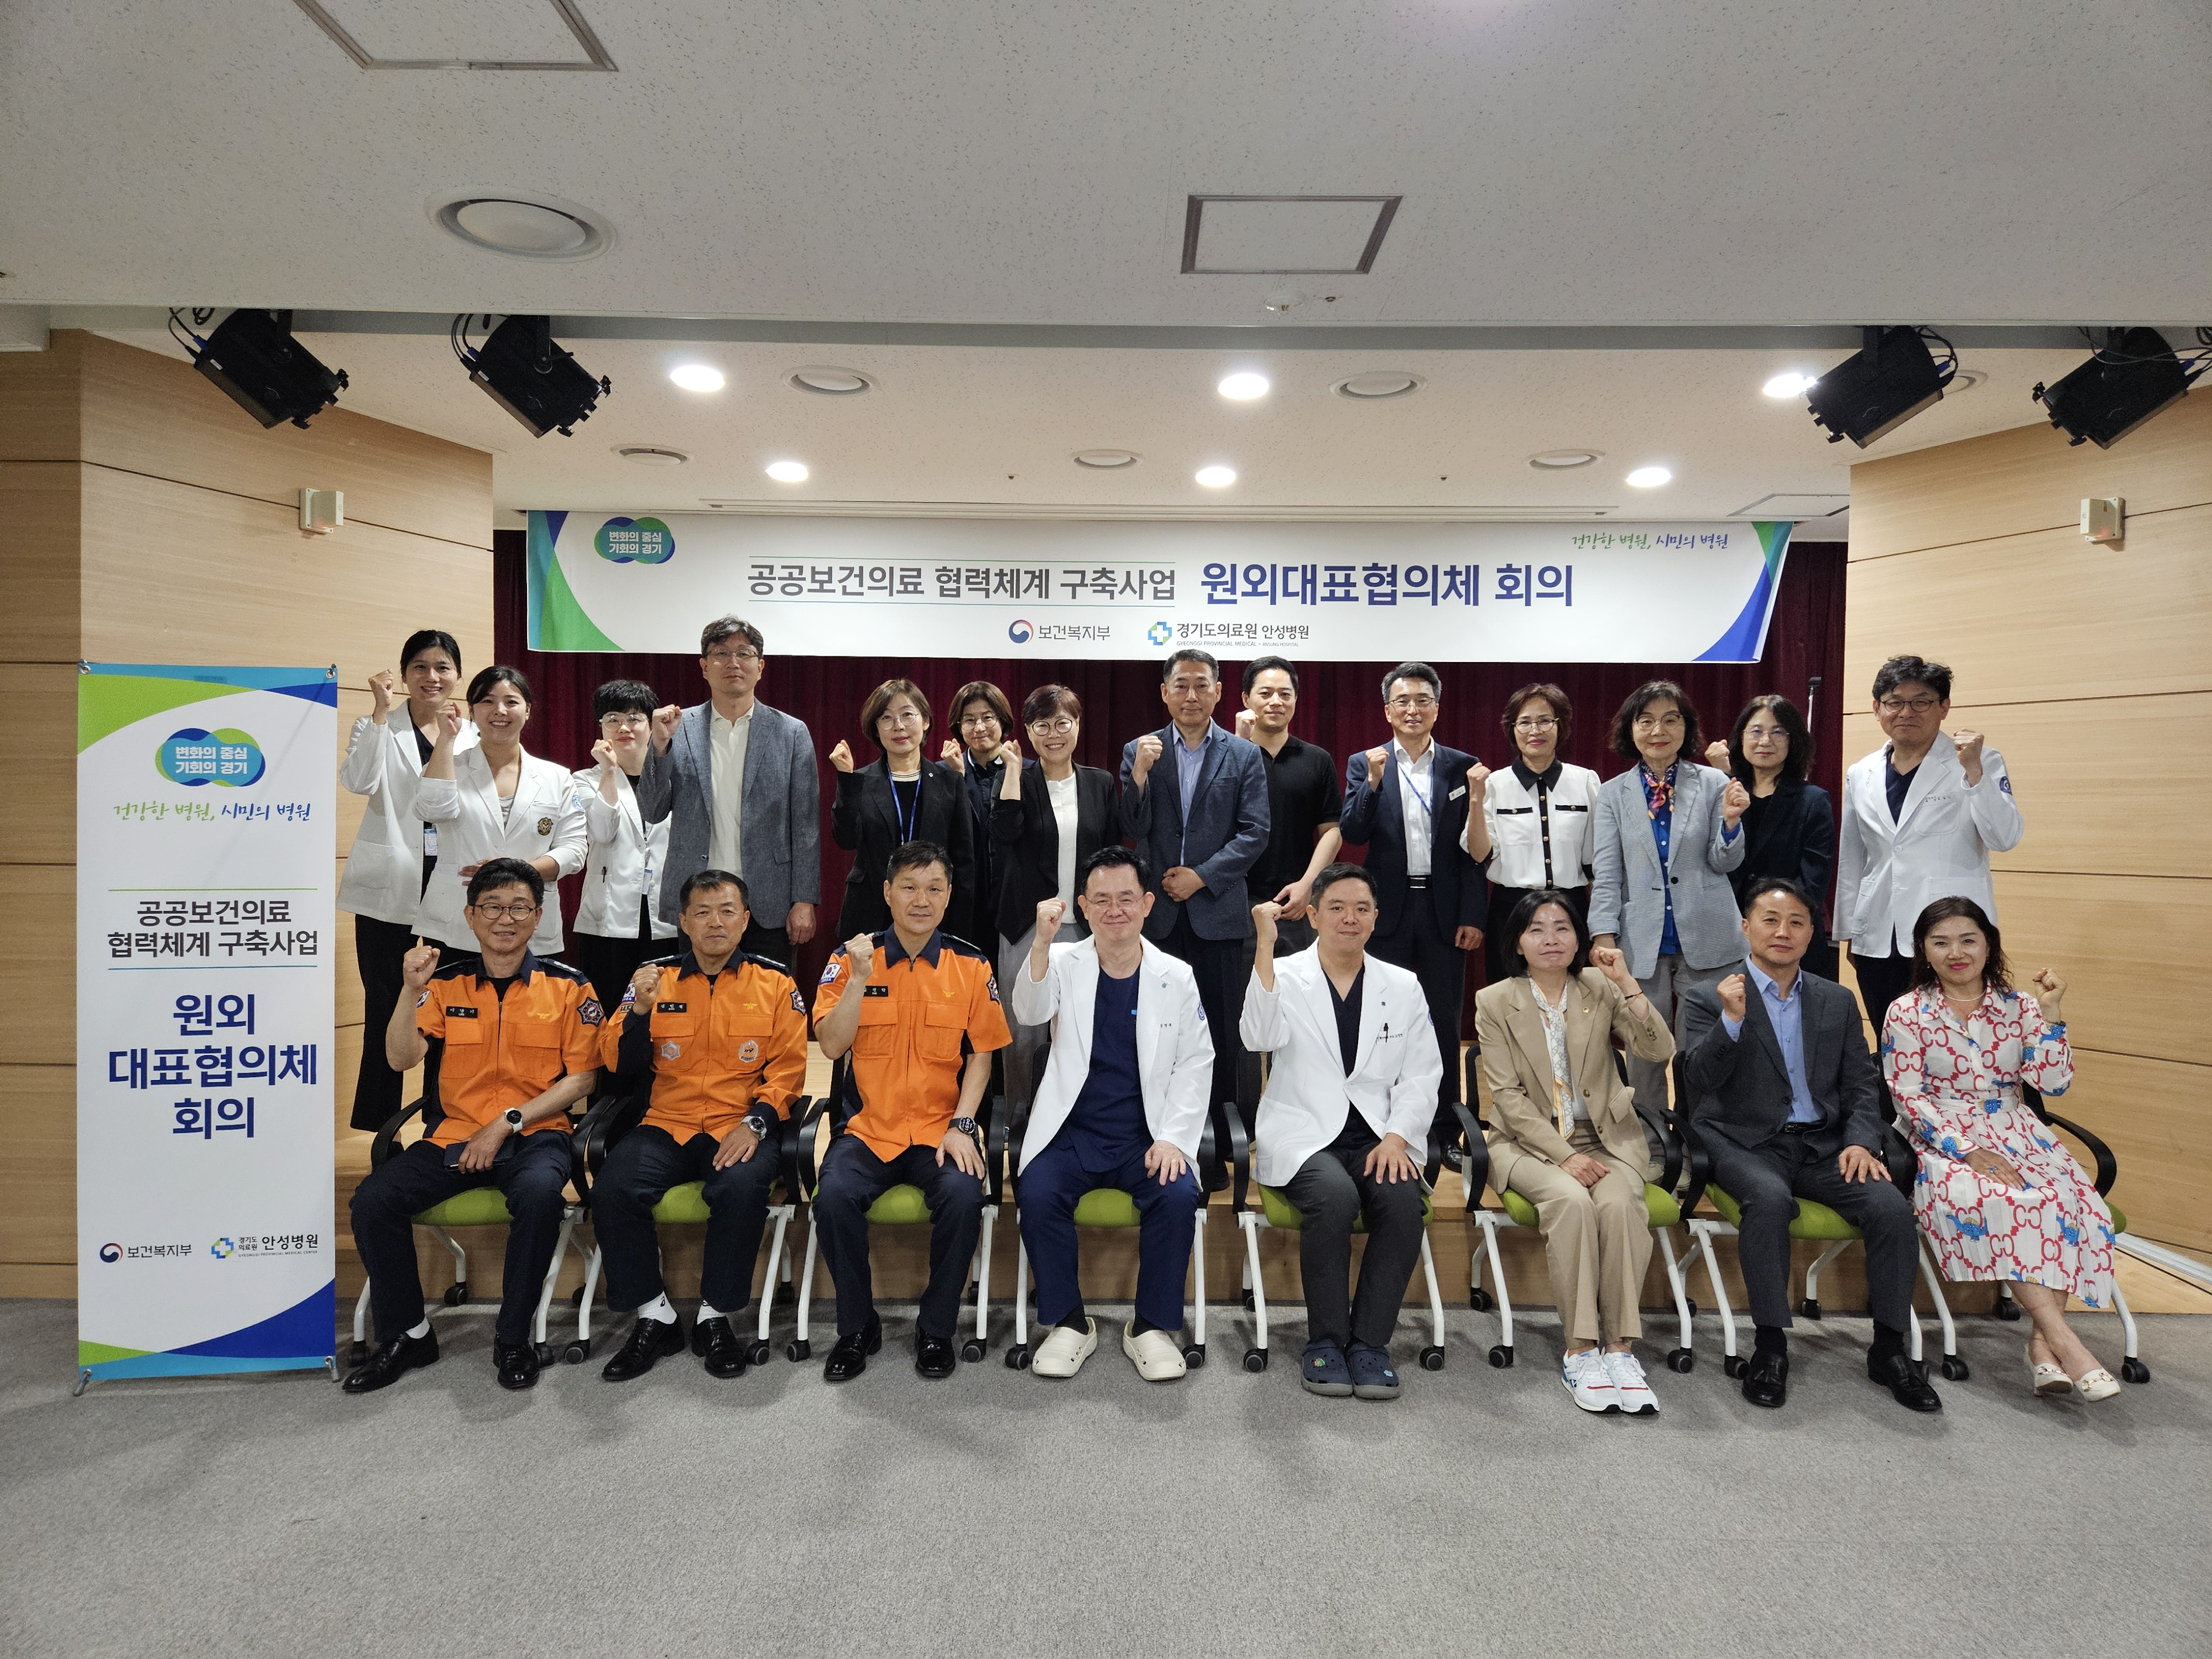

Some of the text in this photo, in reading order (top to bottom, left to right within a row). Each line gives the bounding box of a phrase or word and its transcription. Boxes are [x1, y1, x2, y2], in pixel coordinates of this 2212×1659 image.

[609, 531, 662, 542] 변화의 중심
[1571, 532, 1728, 550] 건강한 병원, 시민의 병원
[609, 543, 661, 554] 기회의 경기
[748, 564, 1176, 600] 공공보건의료 협력체계 구축사업
[1201, 562, 1573, 607] 원외대표협의체 회의
[1038, 625, 1110, 641] 보건복지부
[1177, 623, 1309, 640] 경기도의료원 안성병원
[175, 746, 247, 760] 변화의 중심
[175, 761, 247, 774] 기회의 경기
[113, 800, 311, 821] 건강한 병원, 시민의 병원
[137, 900, 291, 927] 공공보건의료
[107, 930, 317, 958] 협력체계 구축사업
[173, 994, 255, 1036] 원외
[109, 1044, 316, 1089] 대표협의체
[173, 1097, 254, 1140] 회의
[127, 1244, 192, 1258] 보건복지부
[262, 1234, 318, 1250] 안성병원
